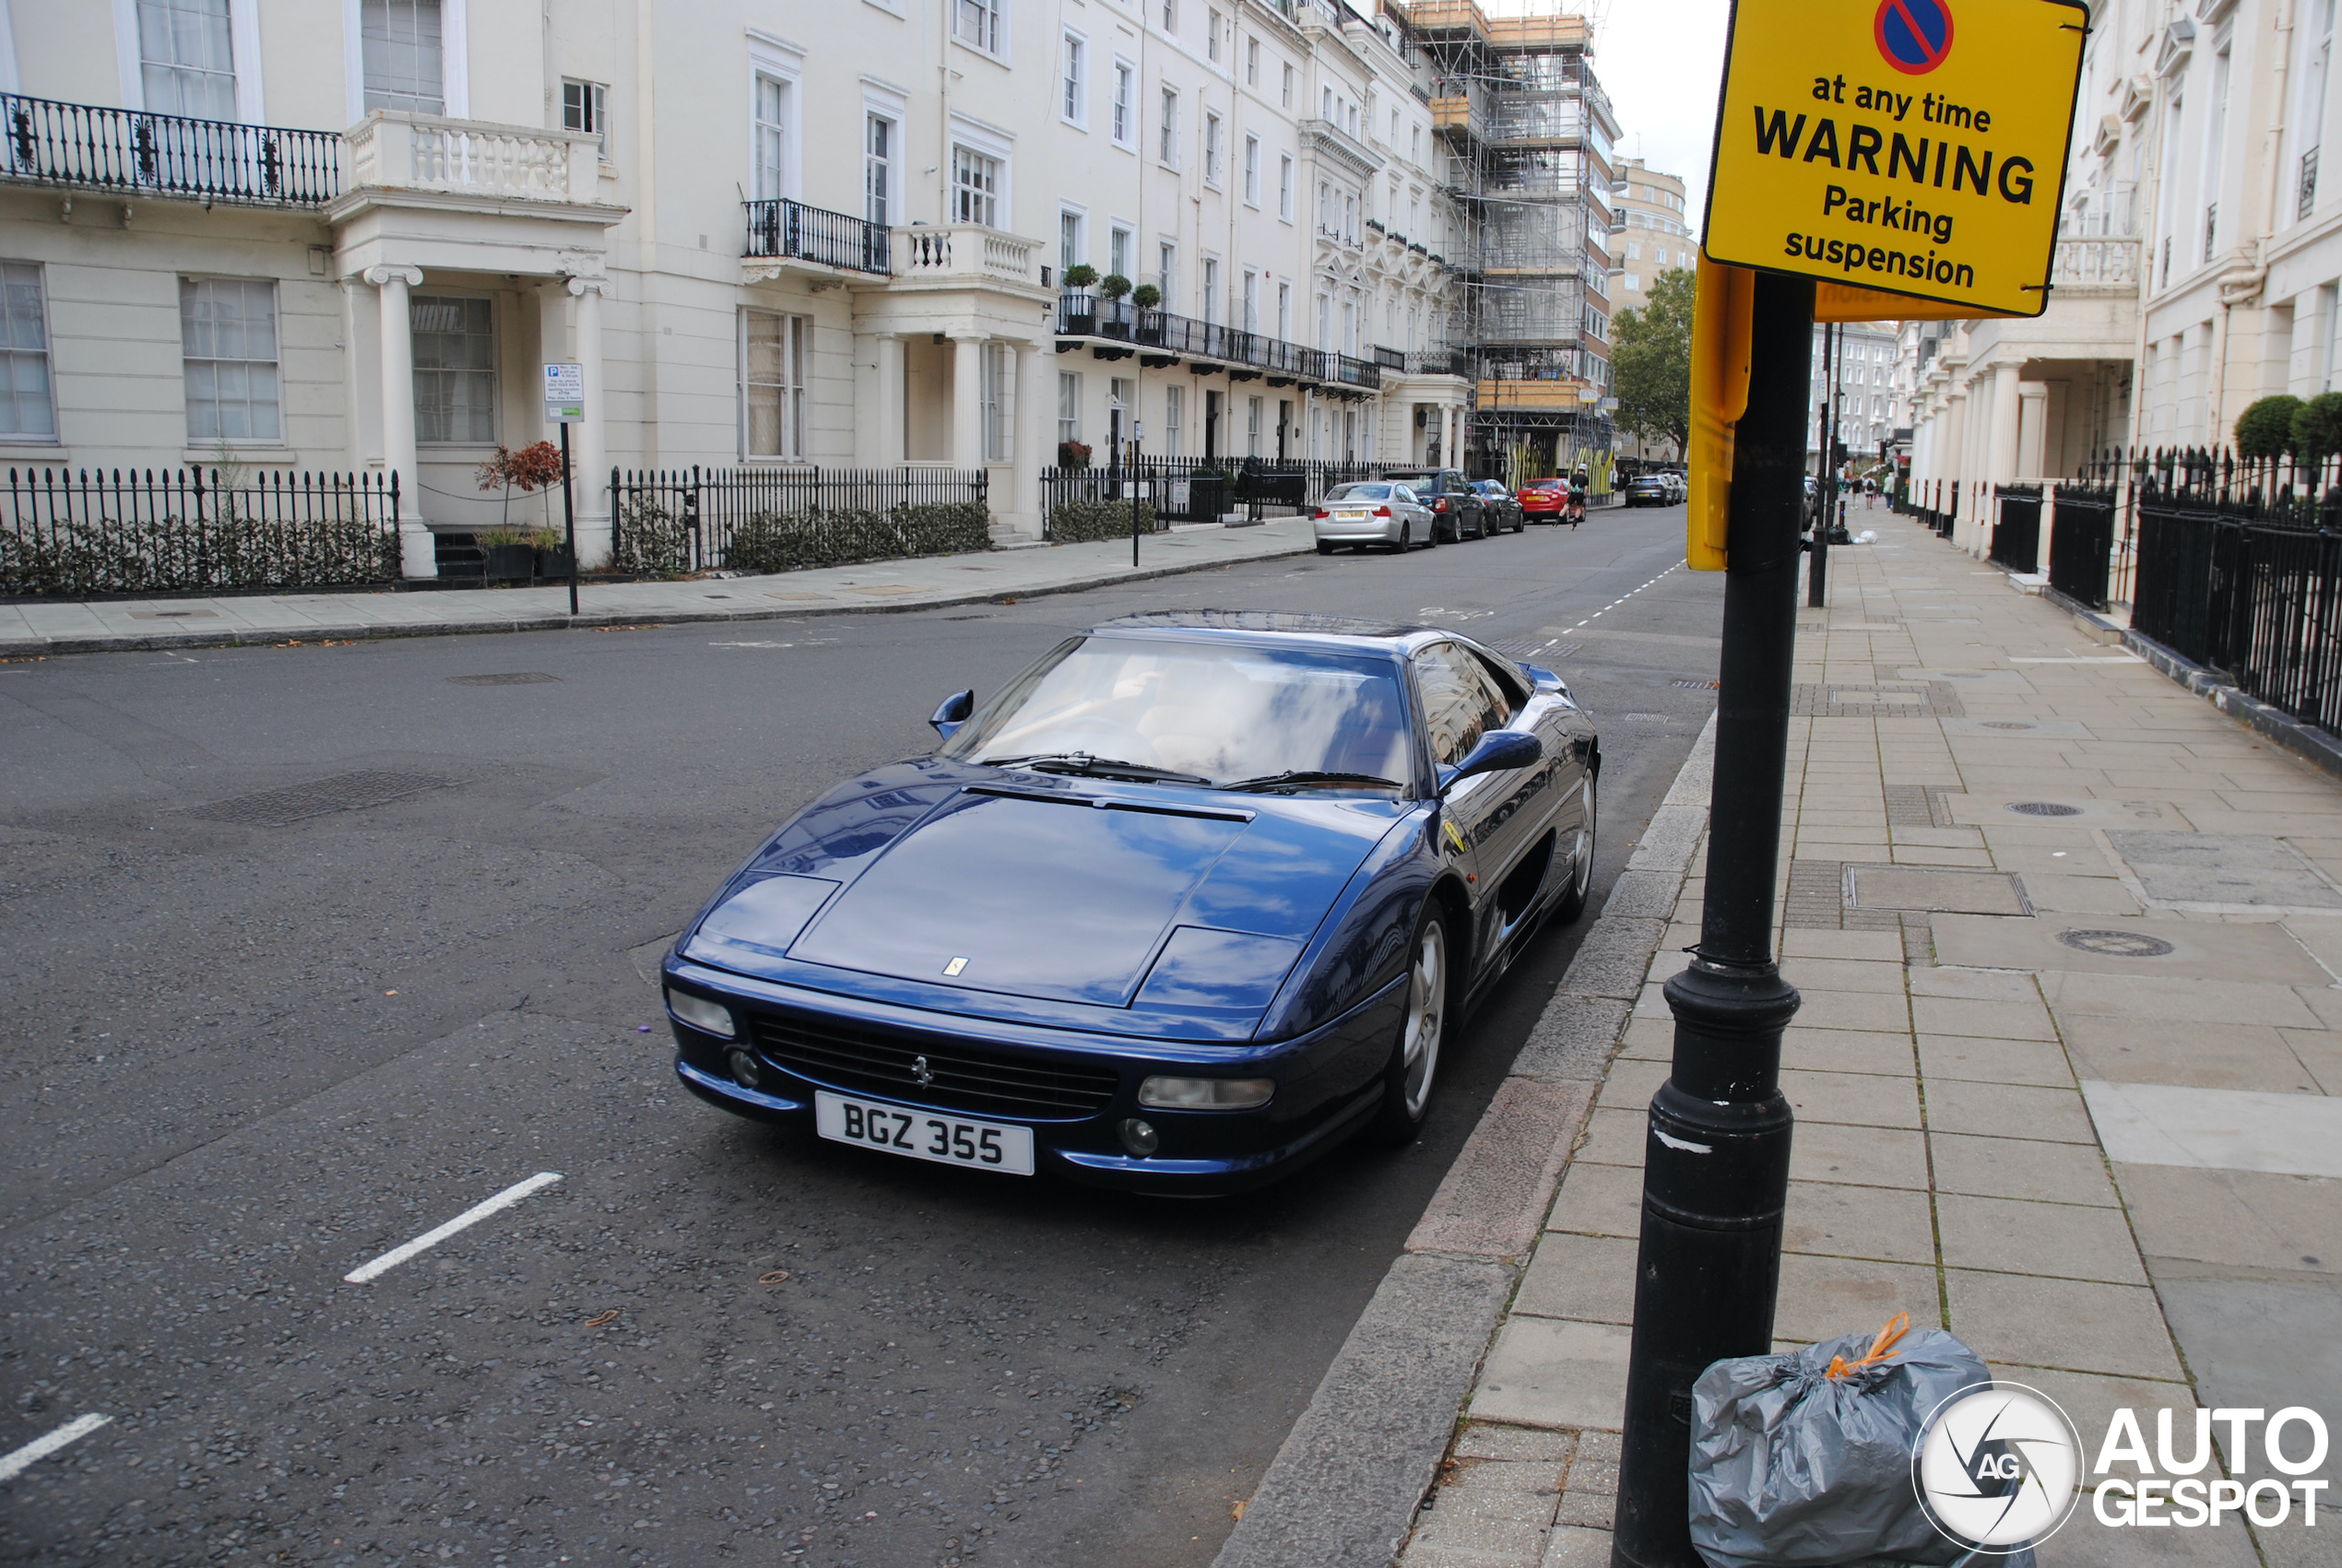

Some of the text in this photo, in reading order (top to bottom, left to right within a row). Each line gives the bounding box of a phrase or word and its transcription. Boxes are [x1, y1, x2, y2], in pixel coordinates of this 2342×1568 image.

[1812, 74, 1992, 133] at any time
[1753, 105, 2035, 205] WARNING
[1823, 184, 1954, 244] Parking
[1784, 231, 1974, 288] suspension
[843, 1102, 1002, 1164] BGZ 355
